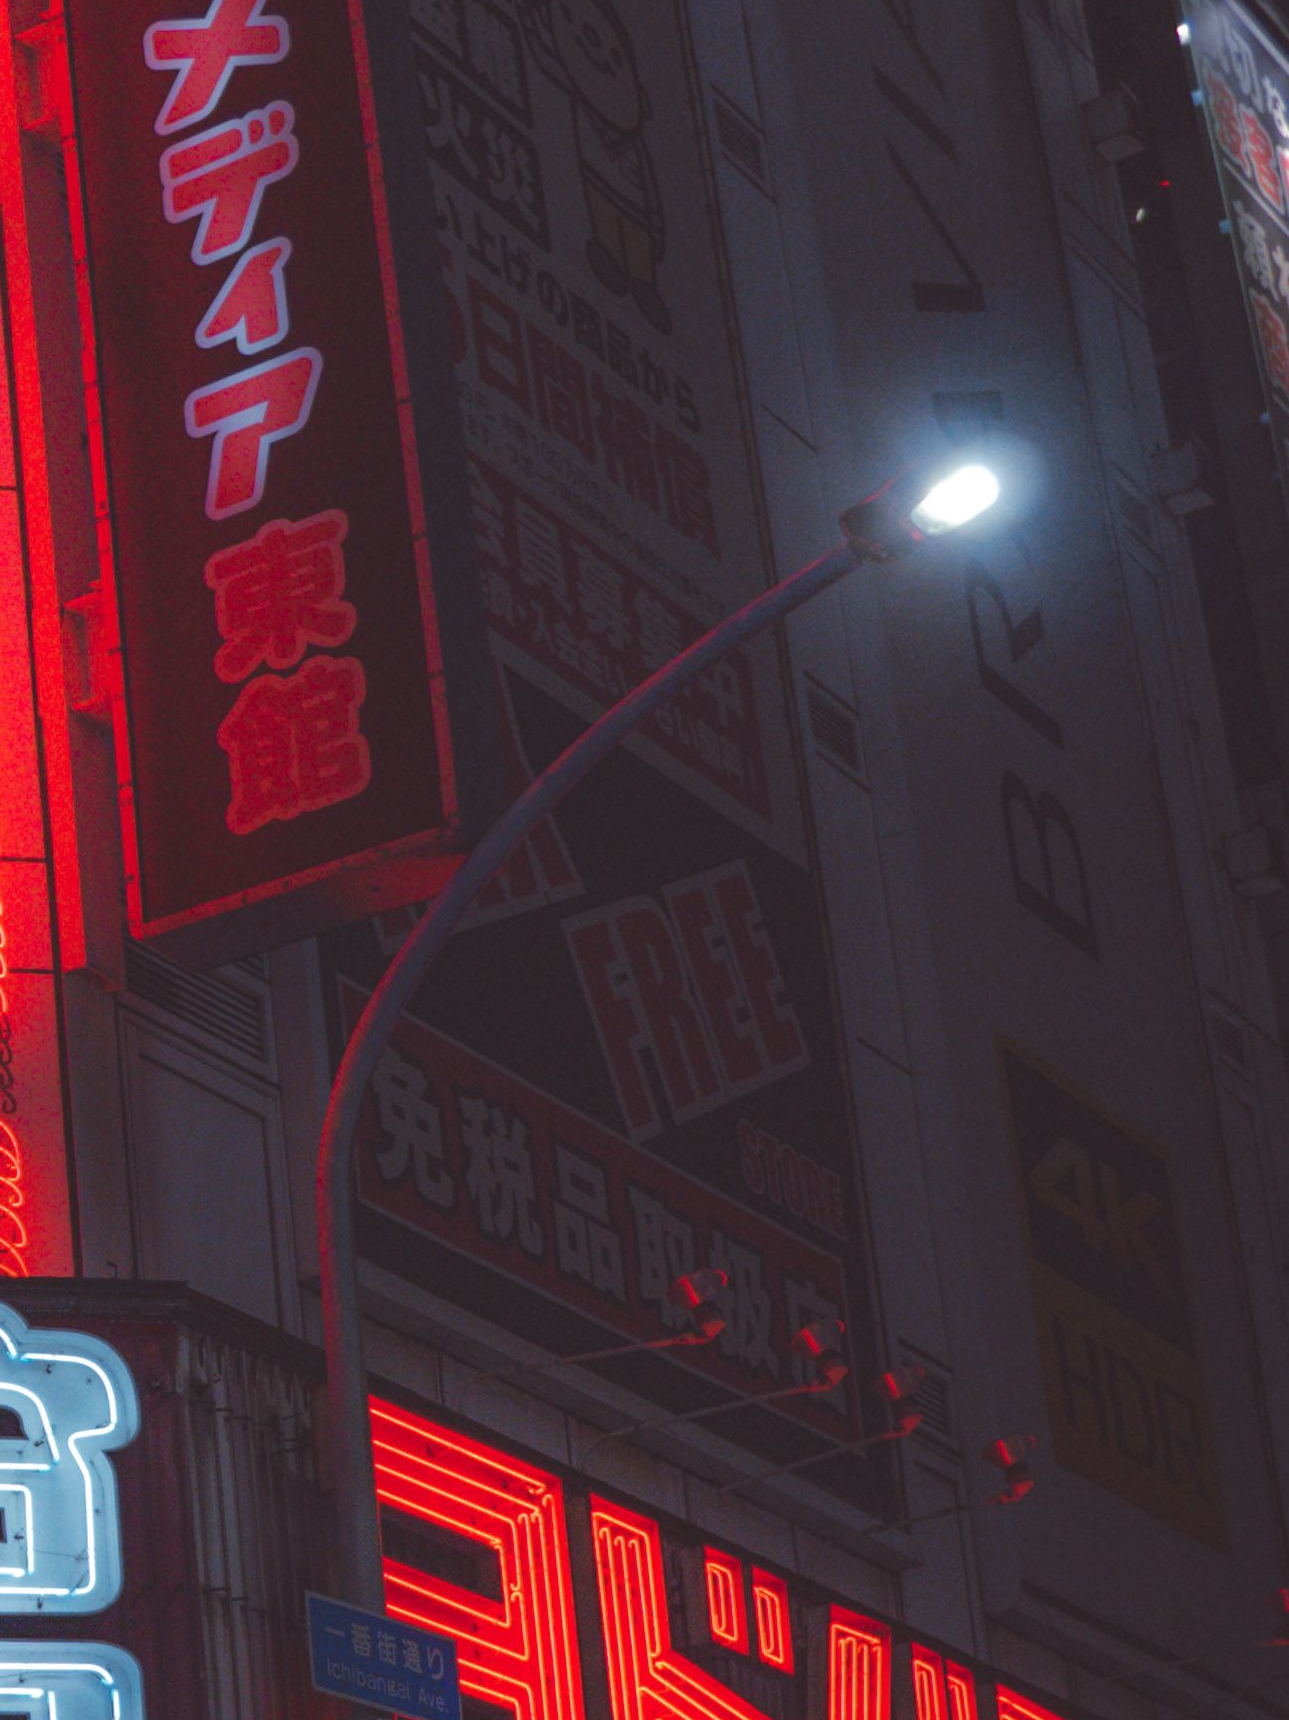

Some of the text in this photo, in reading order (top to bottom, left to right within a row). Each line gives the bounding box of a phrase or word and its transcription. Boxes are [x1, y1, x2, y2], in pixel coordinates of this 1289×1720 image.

[203, 507, 371, 836] 東館
[561, 860, 811, 1146] FREE
[735, 1117, 849, 1241] STORE
[1030, 1134, 1167, 1270] 4K
[1053, 1313, 1211, 1503] HDR
[323, 1622, 445, 1681] 一番街通り
